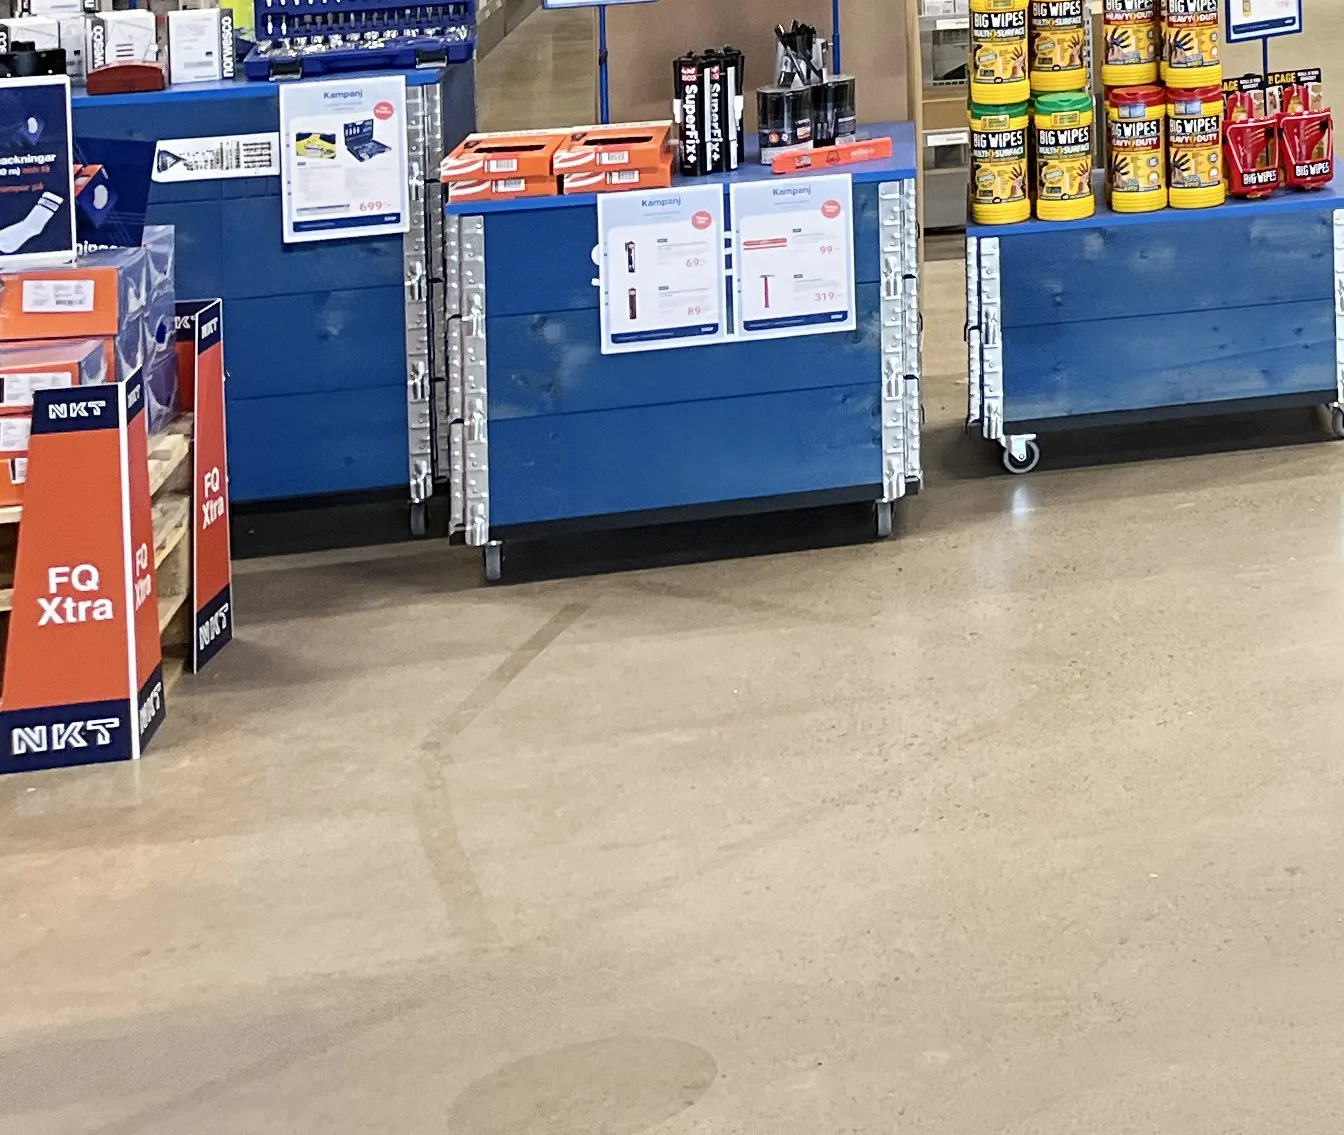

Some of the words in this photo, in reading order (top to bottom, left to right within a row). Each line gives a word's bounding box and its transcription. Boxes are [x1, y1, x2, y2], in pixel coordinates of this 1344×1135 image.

[1032, 2, 1048, 17] BIG
[1049, 0, 1081, 16] WIPES
[974, 15, 988, 28] BIG
[989, 13, 1024, 27] WIPES
[221, 16, 234, 78] norwesco
[323, 89, 363, 100] Kampanj
[1223, 79, 1239, 92] AGE
[1125, 121, 1157, 137] WIPES
[1184, 117, 1217, 134] WIPES
[973, 133, 988, 148] BIG
[989, 132, 1023, 147] WIPES
[1039, 130, 1055, 145] BIG
[1056, 128, 1089, 144] WIPES
[1258, 169, 1277, 183] WIPES
[773, 186, 811, 197] Kampanj
[641, 196, 682, 207] Kampanj
[48, 400, 106, 420] NKT
[204, 466, 220, 497] FQ
[202, 494, 226, 529] Xtra
[134, 542, 149, 576] FQ
[48, 564, 100, 594] FQ
[134, 574, 152, 612] Xtra
[37, 596, 114, 626] Xtra
[199, 602, 229, 651] NKT
[139, 681, 162, 734] NKT
[11, 717, 121, 756] NKT
